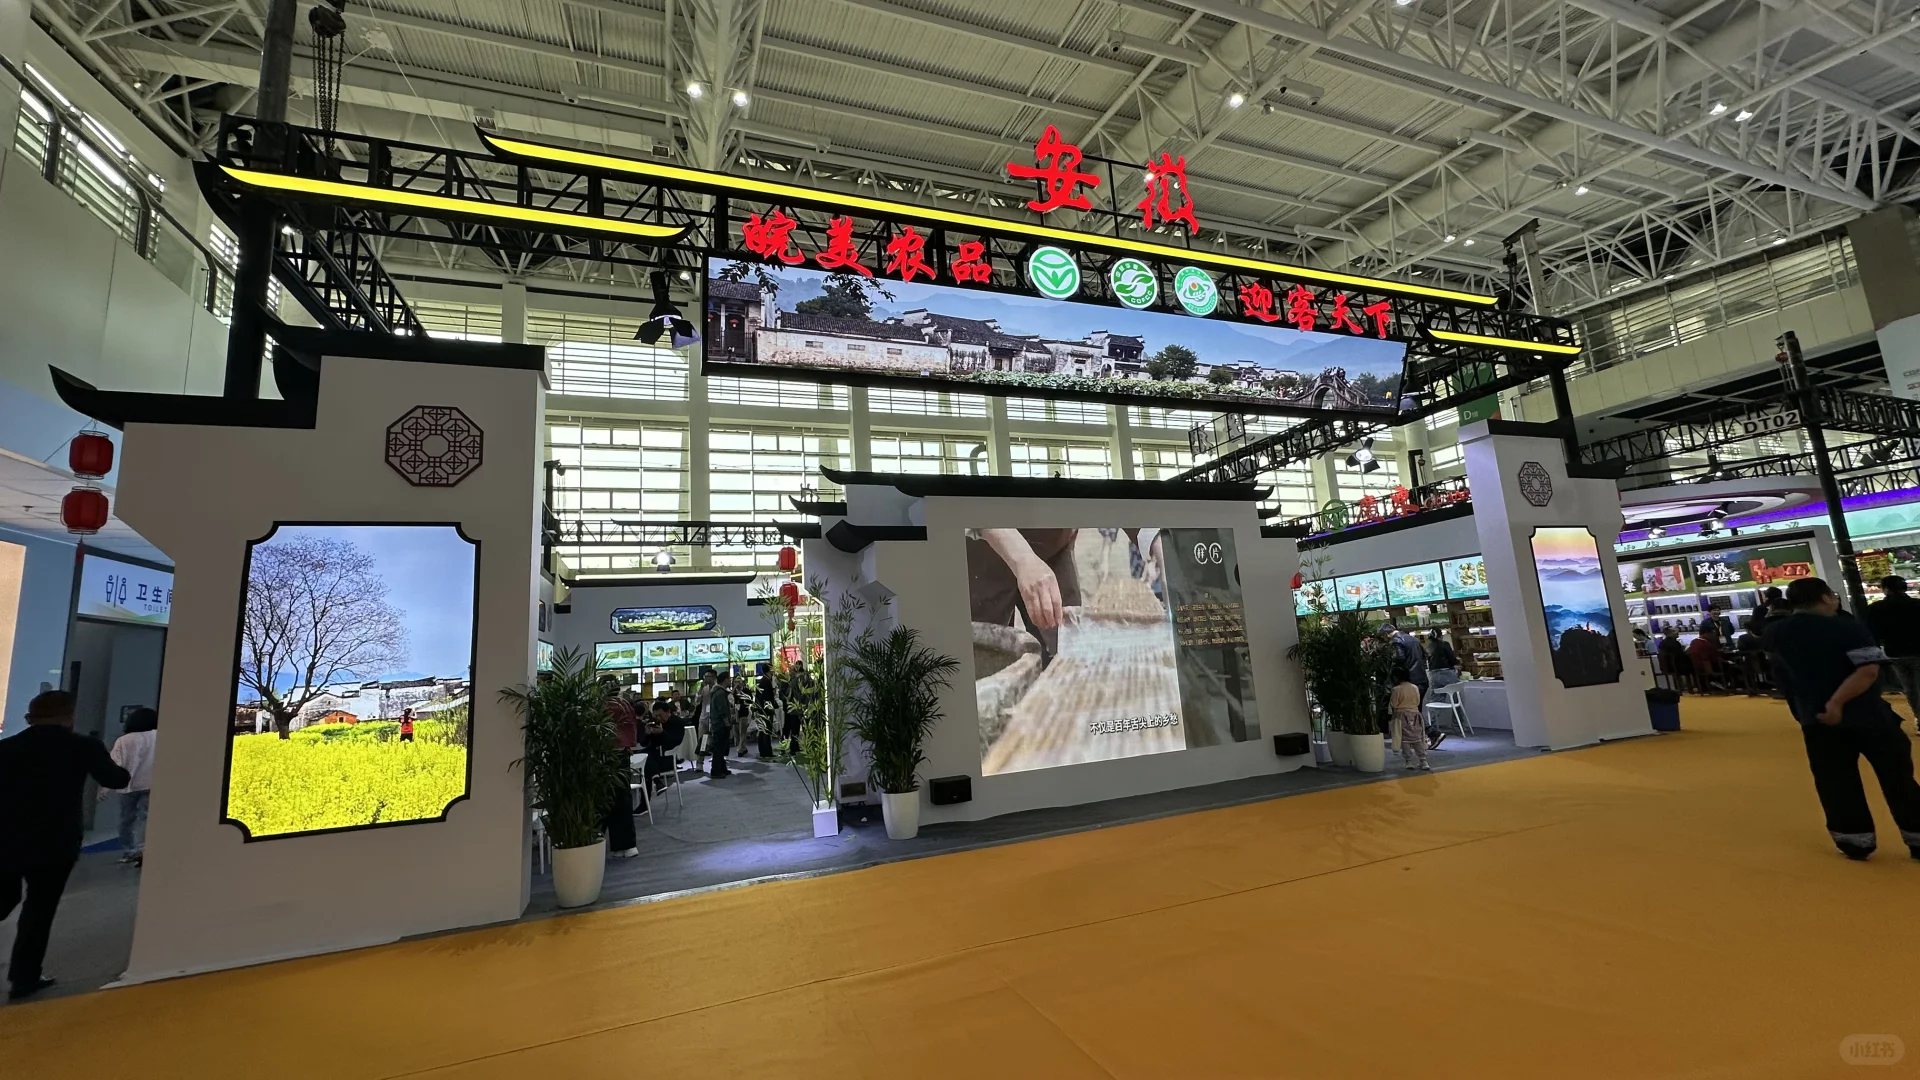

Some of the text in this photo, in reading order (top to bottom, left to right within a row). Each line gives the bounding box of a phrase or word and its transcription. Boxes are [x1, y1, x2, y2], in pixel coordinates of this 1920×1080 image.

[742, 209, 1392, 339] 皖美农品 迎客天下
[1743, 411, 1799, 434] DT02
[144, 603, 168, 613] TOILET
[1089, 713, 1178, 735] 不仅是百年舌尖上的乡愁
